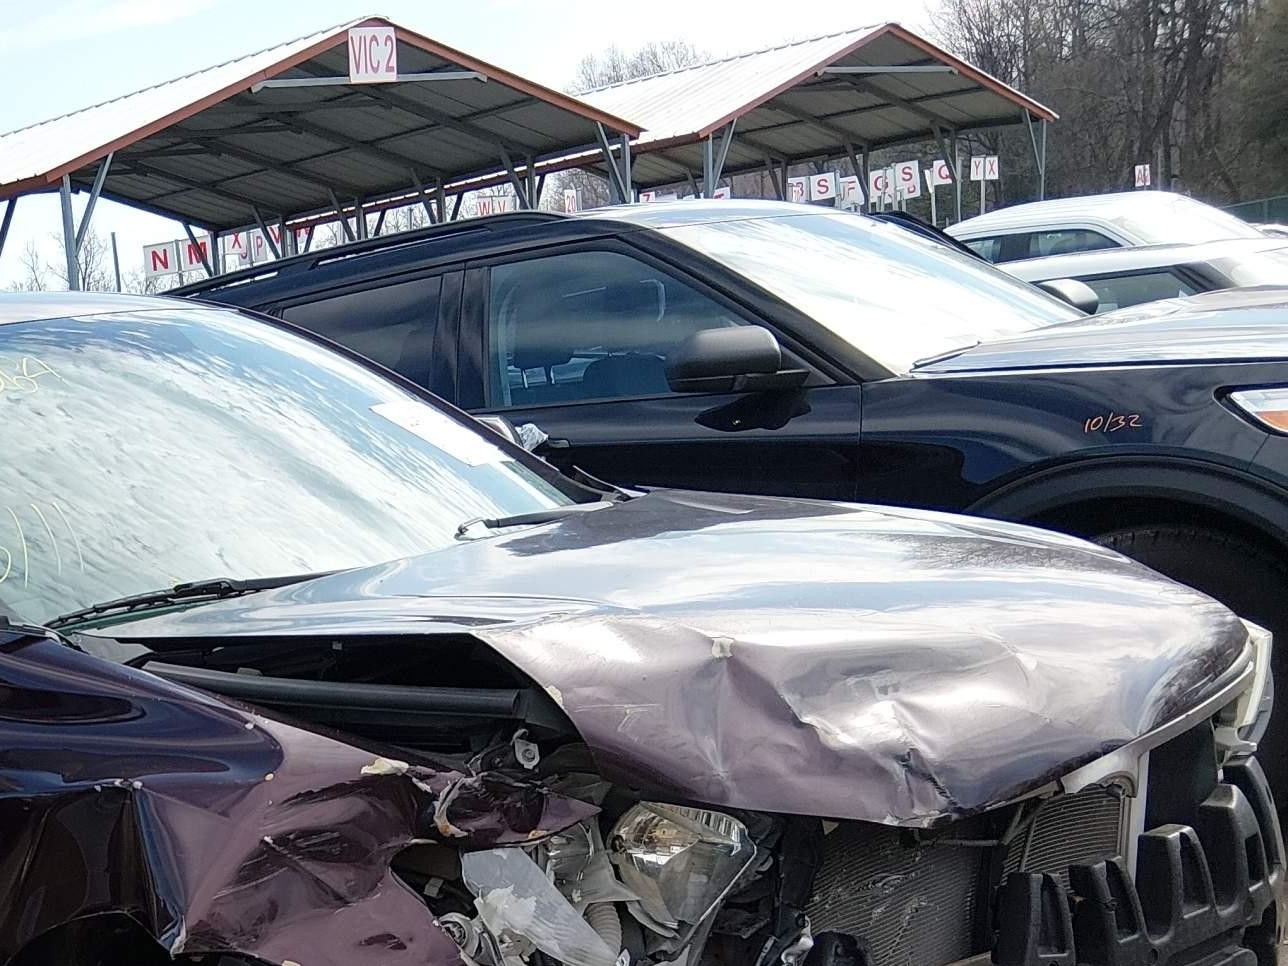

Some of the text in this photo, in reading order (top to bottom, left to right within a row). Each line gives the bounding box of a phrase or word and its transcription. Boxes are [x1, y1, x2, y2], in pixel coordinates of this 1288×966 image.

[350, 34, 395, 74] VIC 2
[901, 166, 913, 182] S
[988, 160, 996, 176] X
[817, 178, 830, 195] S
[151, 248, 169, 272] N
